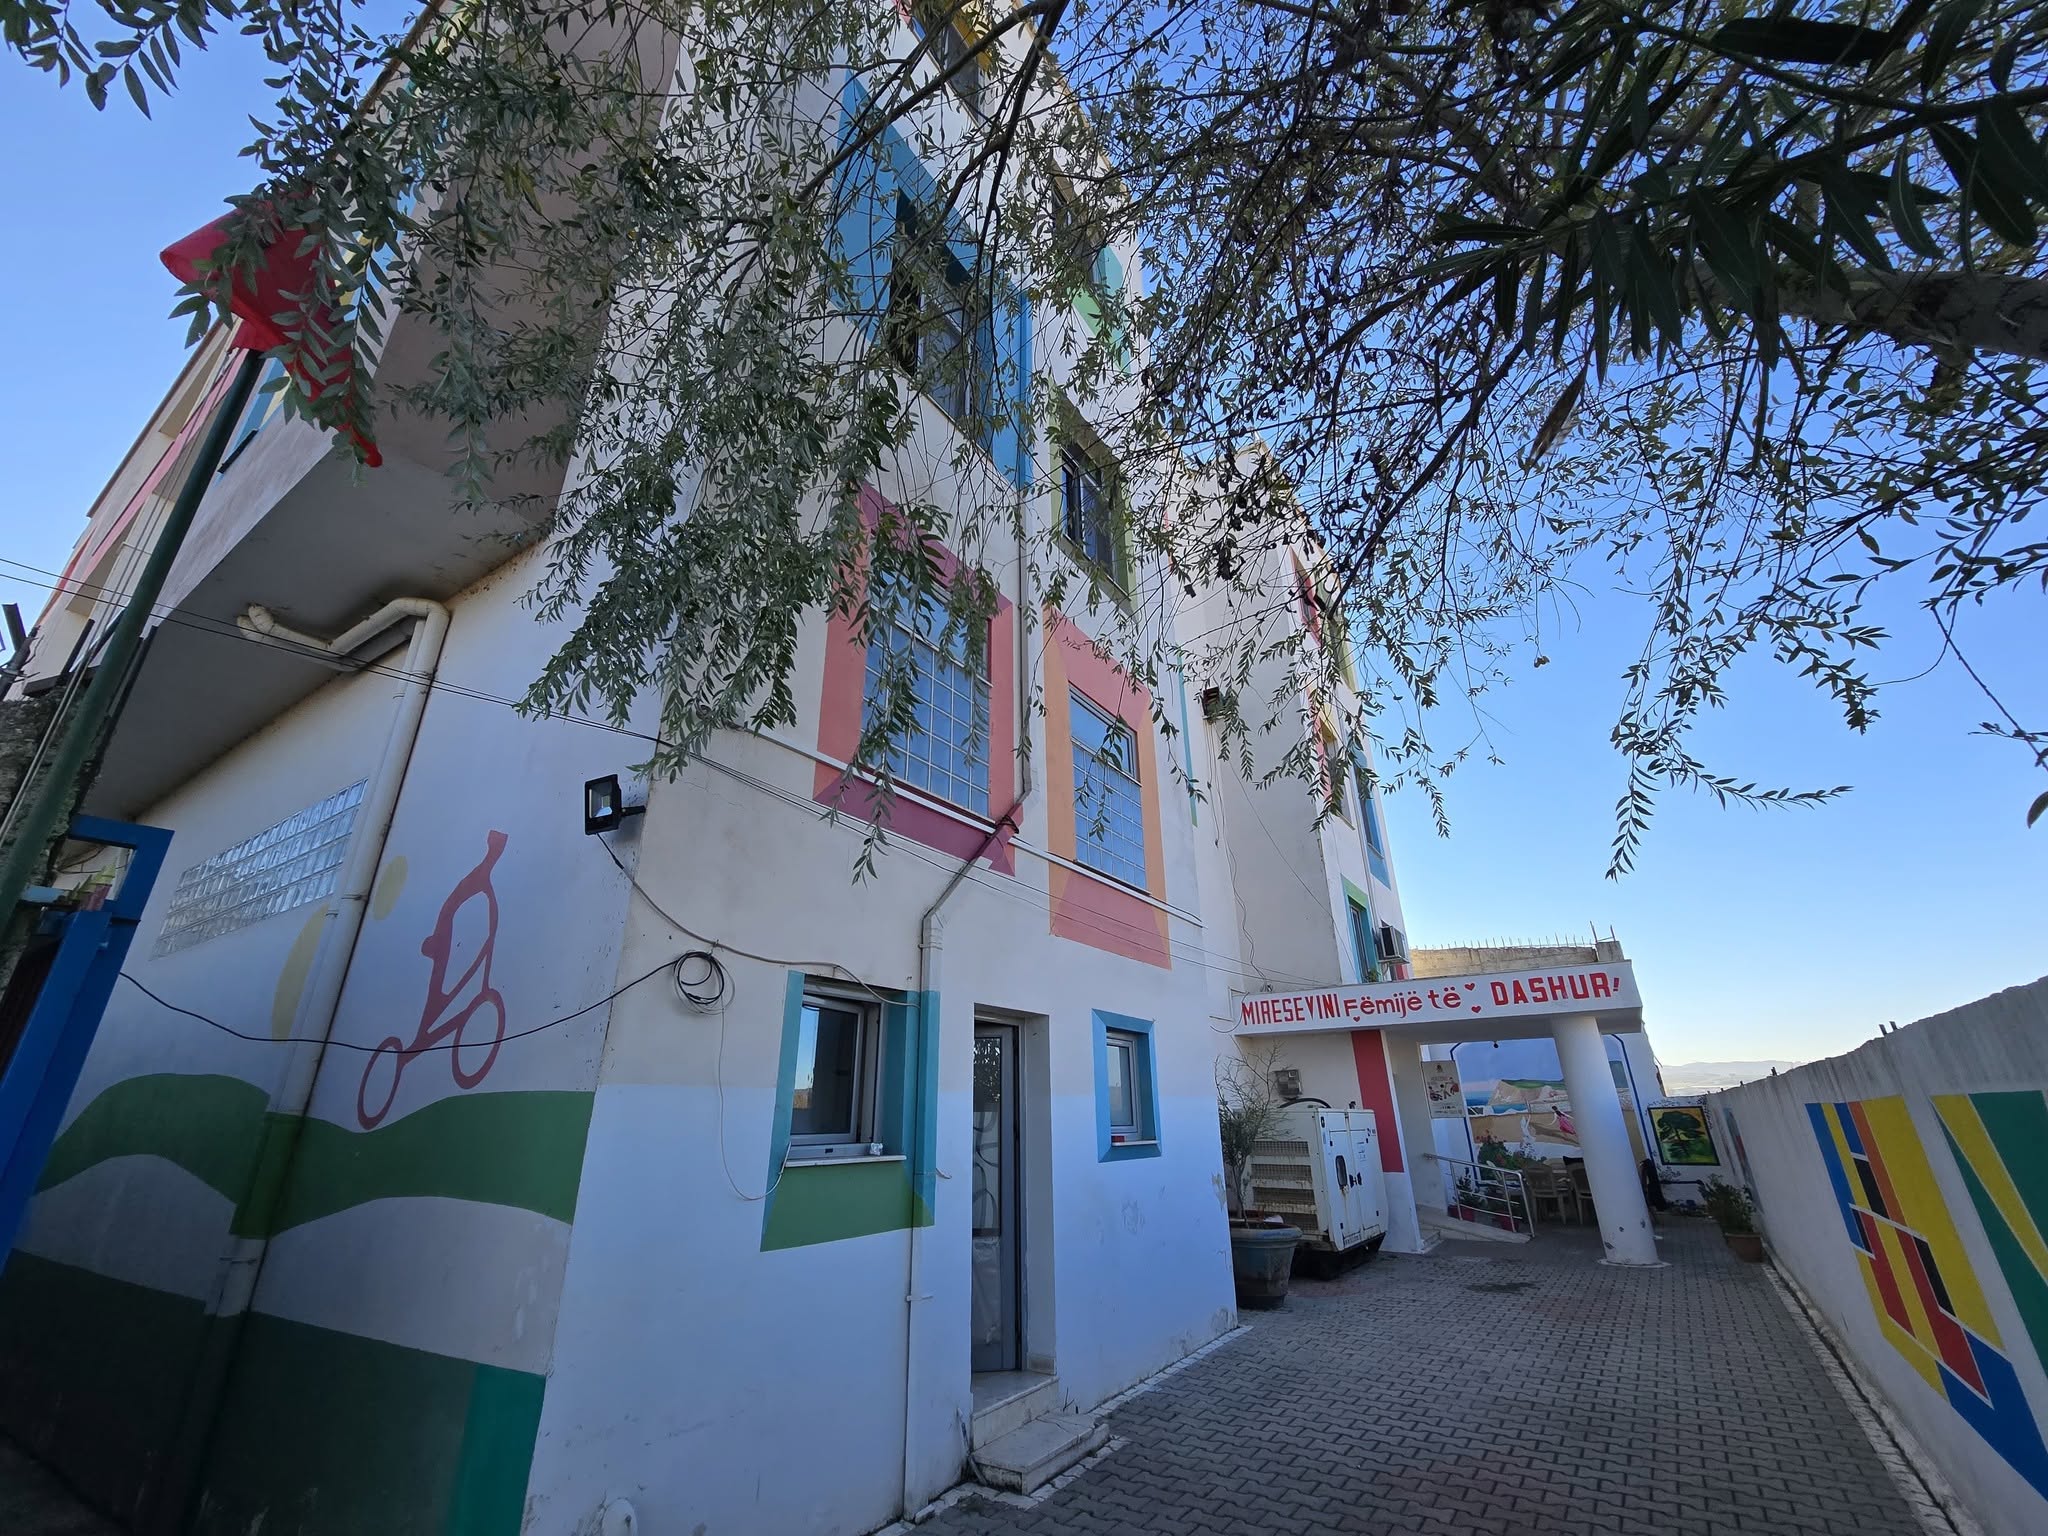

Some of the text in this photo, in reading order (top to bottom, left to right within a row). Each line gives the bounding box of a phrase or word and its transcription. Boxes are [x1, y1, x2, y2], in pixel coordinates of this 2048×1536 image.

[1241, 972, 1620, 1026] MIRESEVINI Fëmijë të DASHUR!
